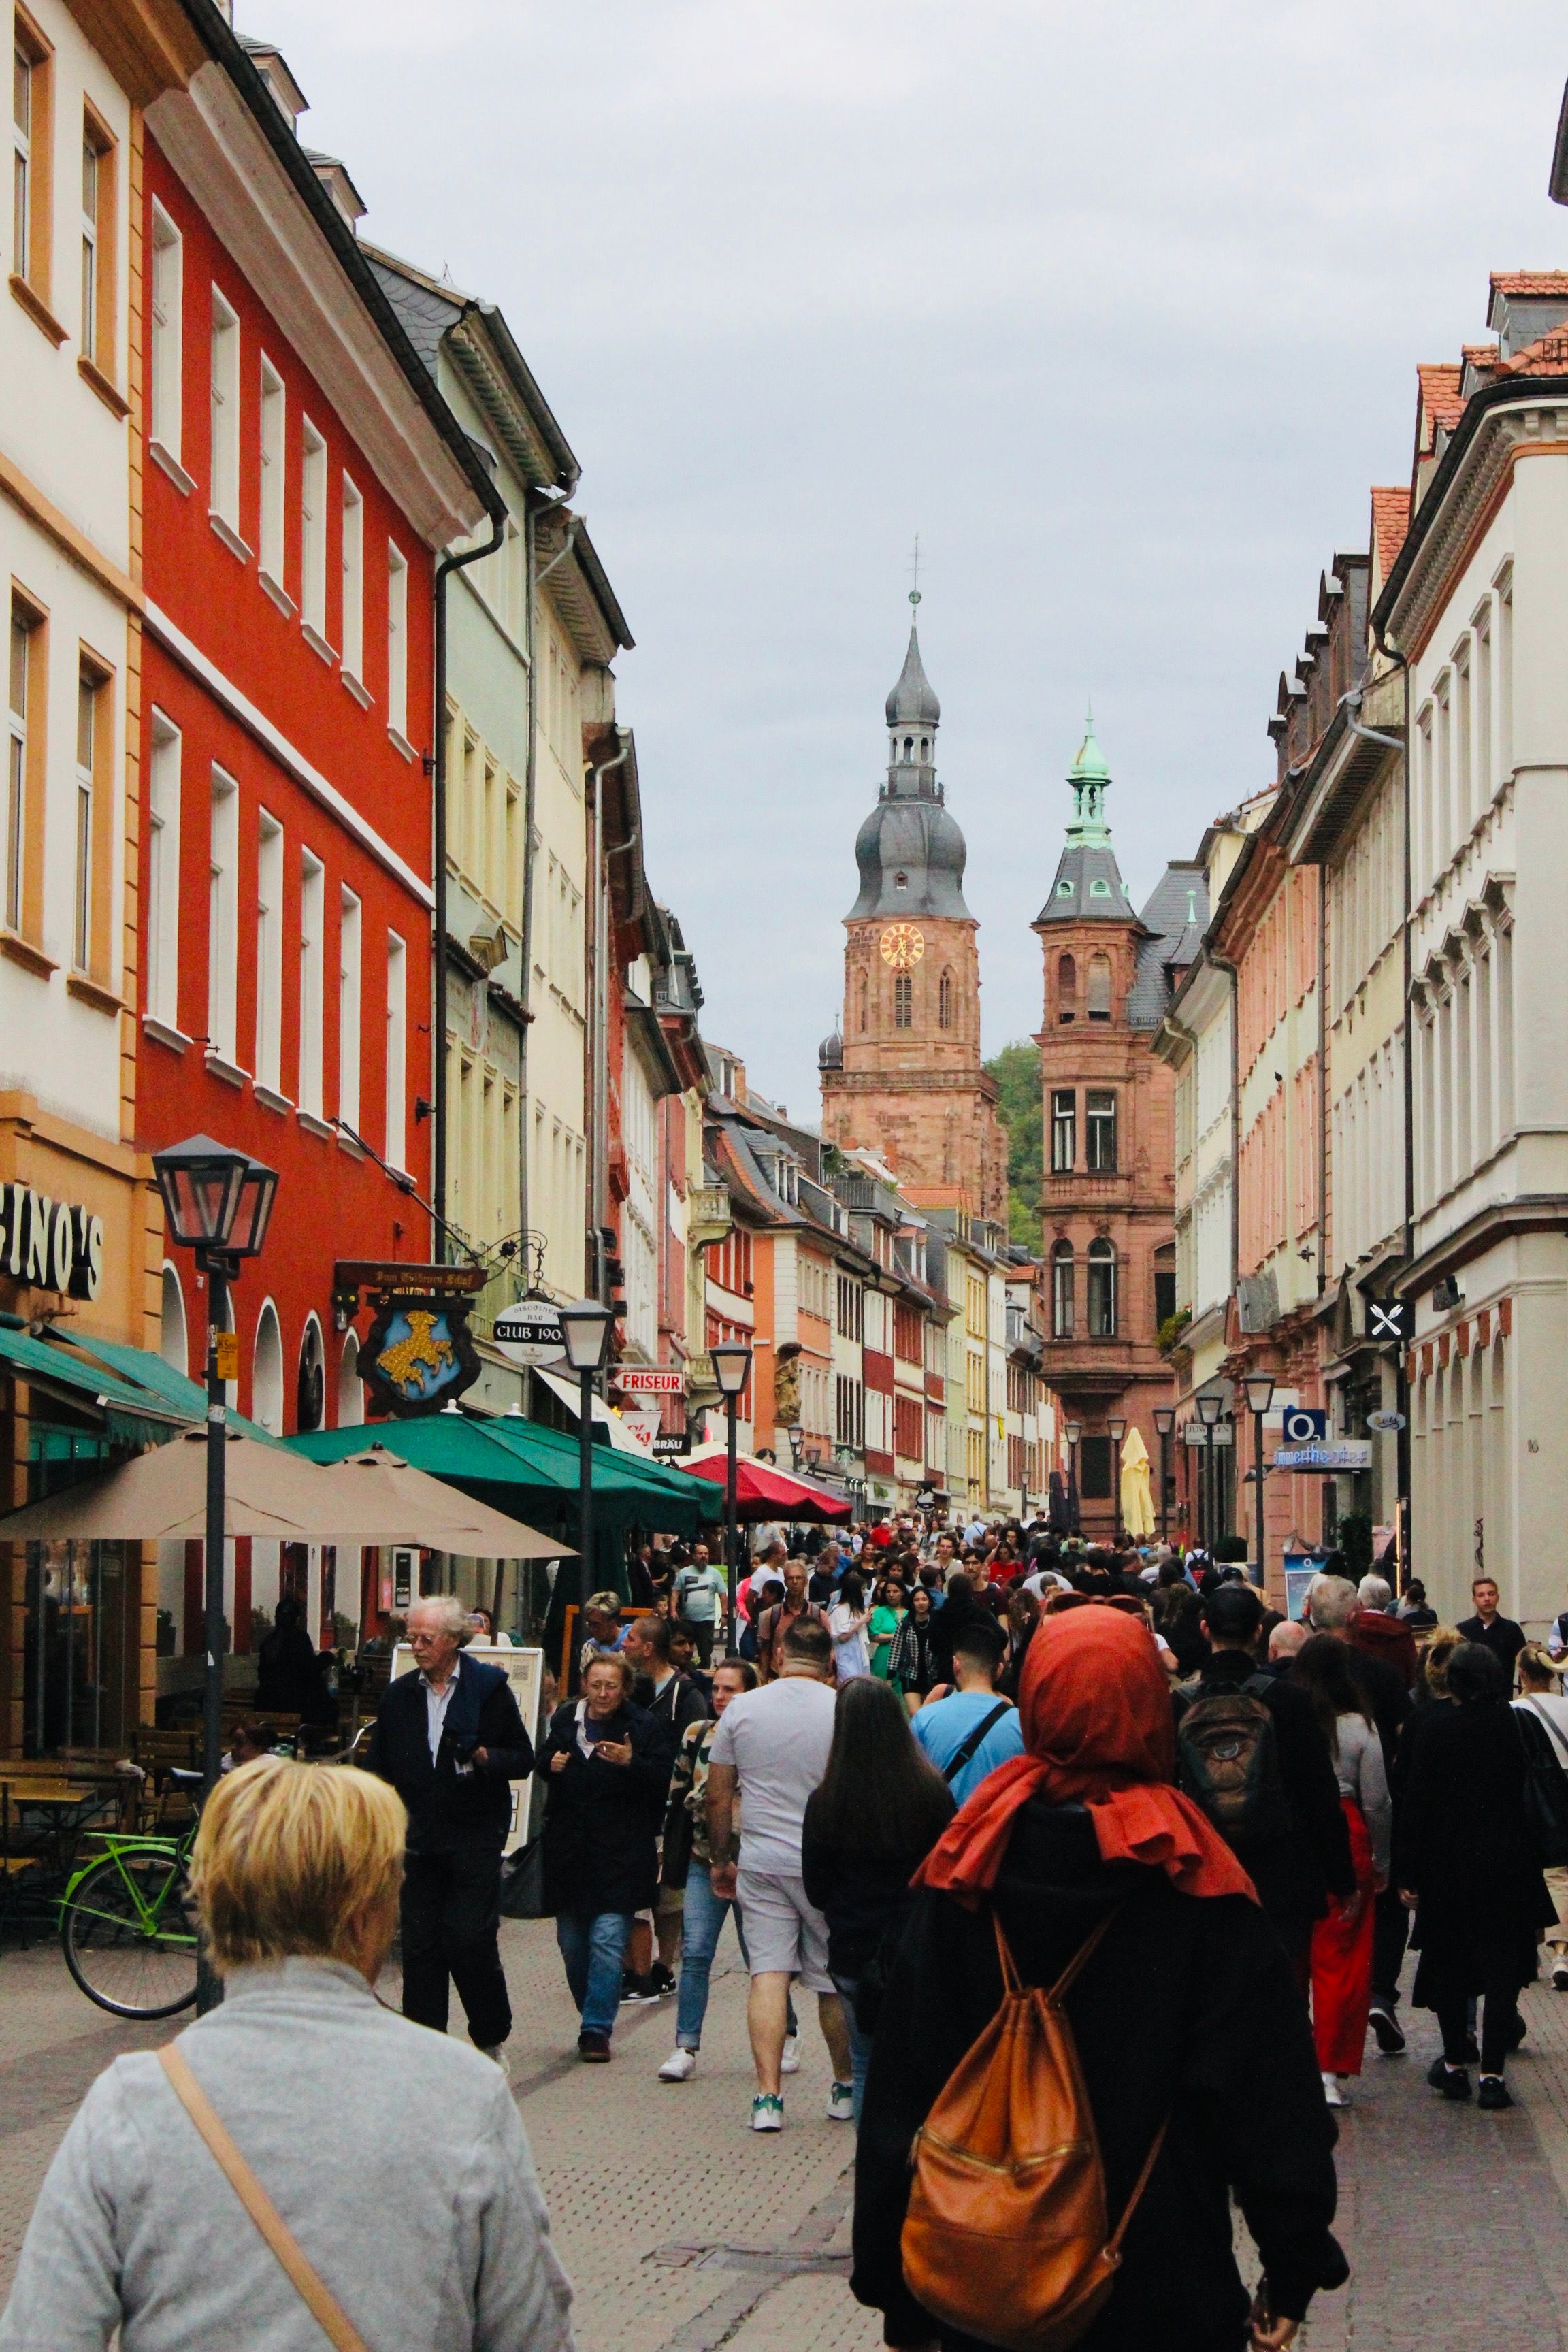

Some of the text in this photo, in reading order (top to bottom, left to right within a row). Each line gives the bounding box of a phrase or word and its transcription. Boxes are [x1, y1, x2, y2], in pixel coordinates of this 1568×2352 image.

[497, 1326, 564, 1341] CLUB 190
[623, 1375, 680, 1390] FRISEUR
[653, 1439, 683, 1450] BRÄU
